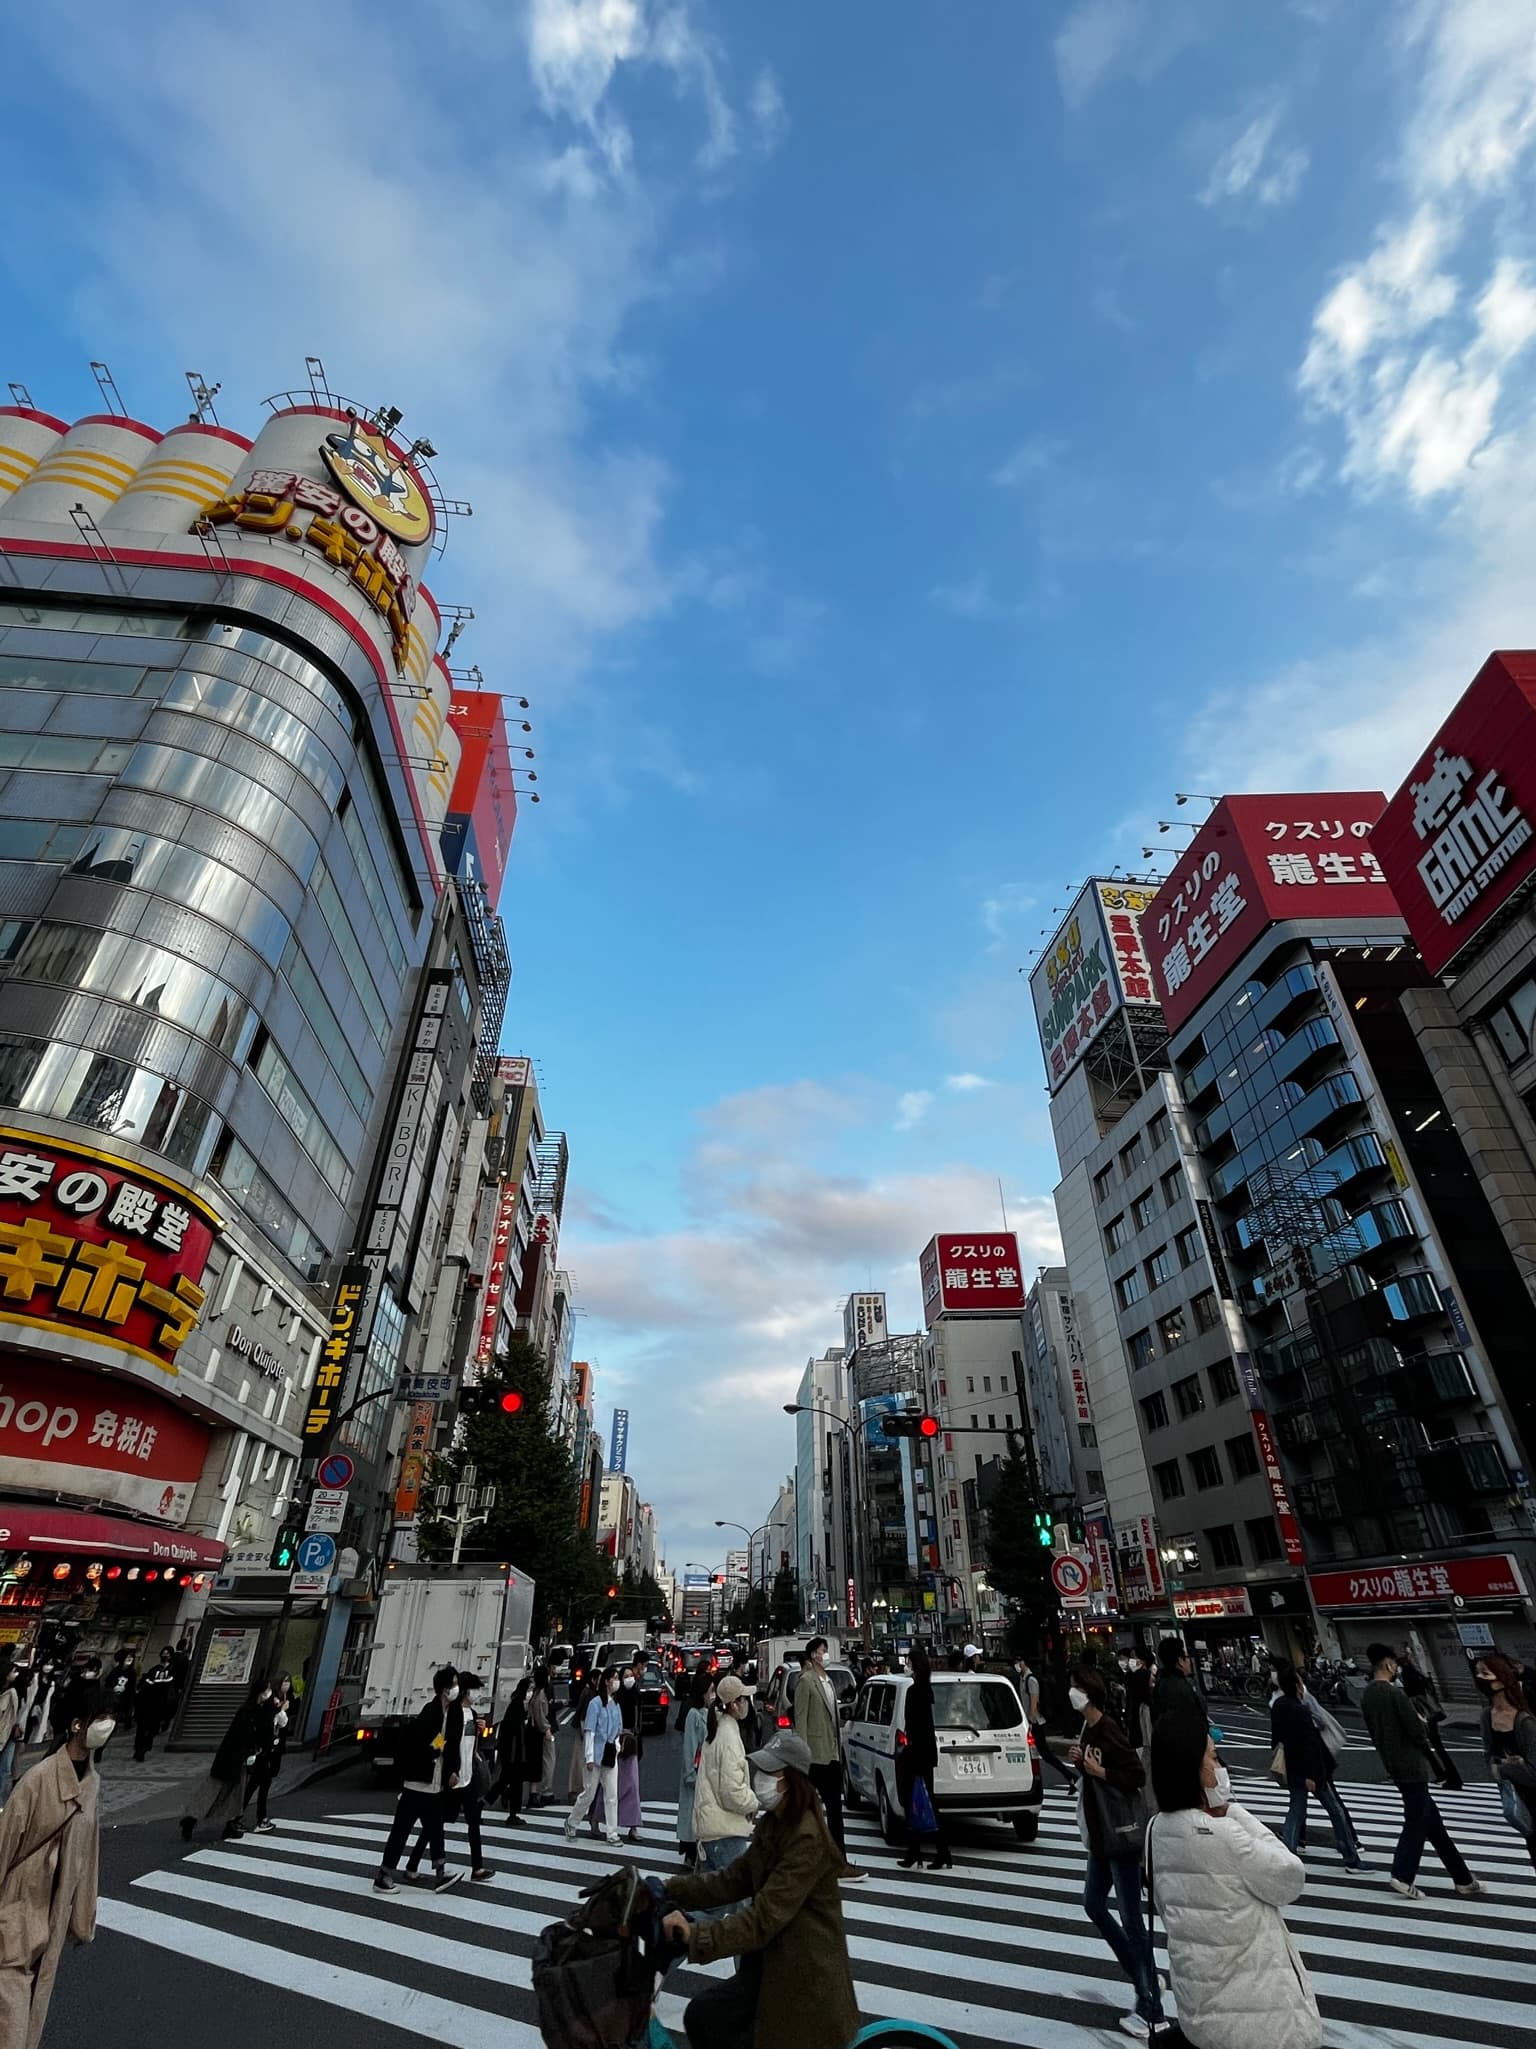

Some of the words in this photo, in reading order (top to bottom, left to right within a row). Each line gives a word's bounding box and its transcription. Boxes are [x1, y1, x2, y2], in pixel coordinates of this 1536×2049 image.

[1264, 820, 1374, 840] クスリの
[1416, 768, 1521, 910] GAME
[1477, 818, 1534, 890] STATION
[1158, 850, 1221, 942] クスリの
[1161, 871, 1248, 996] 龍生堂
[0, 1151, 190, 1253] 安の殿堂
[945, 1266, 1019, 1289] 龍生堂
[950, 1245, 1006, 1259] クスリの
[231, 1325, 251, 1357] Don
[253, 1342, 286, 1380] Quijote
[305, 1283, 362, 1434] ドン・キホーテ
[87, 1409, 158, 1462] 免税店
[152, 1541, 170, 1557] Don
[1349, 1565, 1454, 1599] クスリの龍生堂
